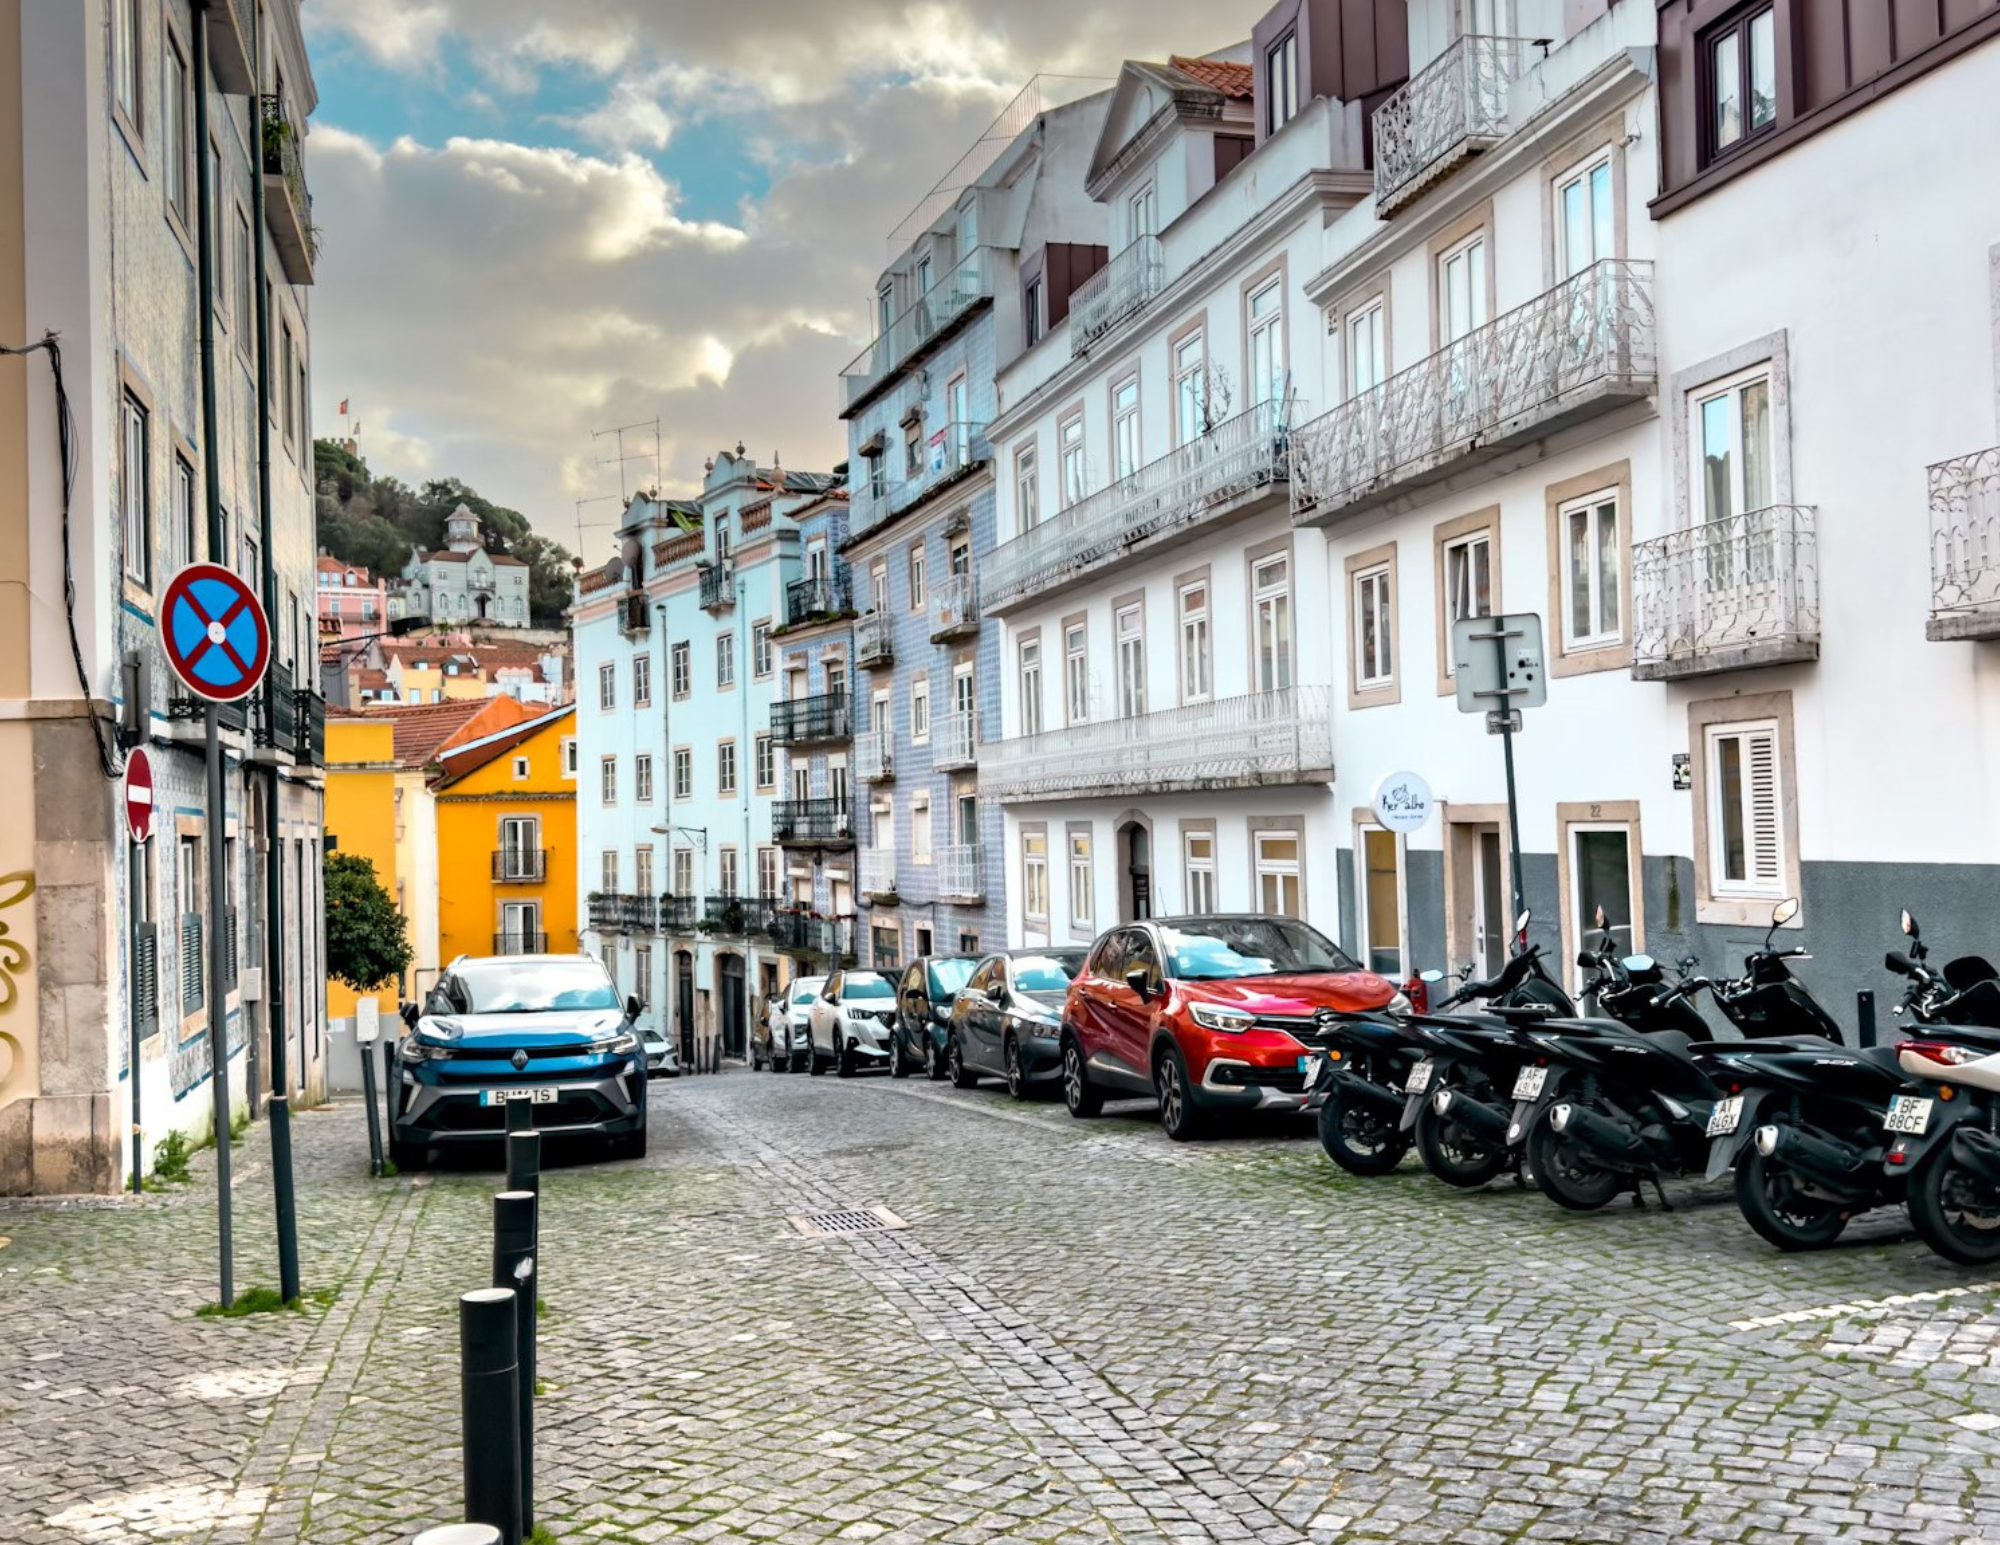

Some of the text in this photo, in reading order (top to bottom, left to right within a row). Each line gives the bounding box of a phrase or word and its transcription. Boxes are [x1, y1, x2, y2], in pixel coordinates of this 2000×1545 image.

[1590, 804, 1602, 818] 22
[1900, 1099, 1920, 1114] BF
[1888, 1114, 1924, 1129] 88CF
